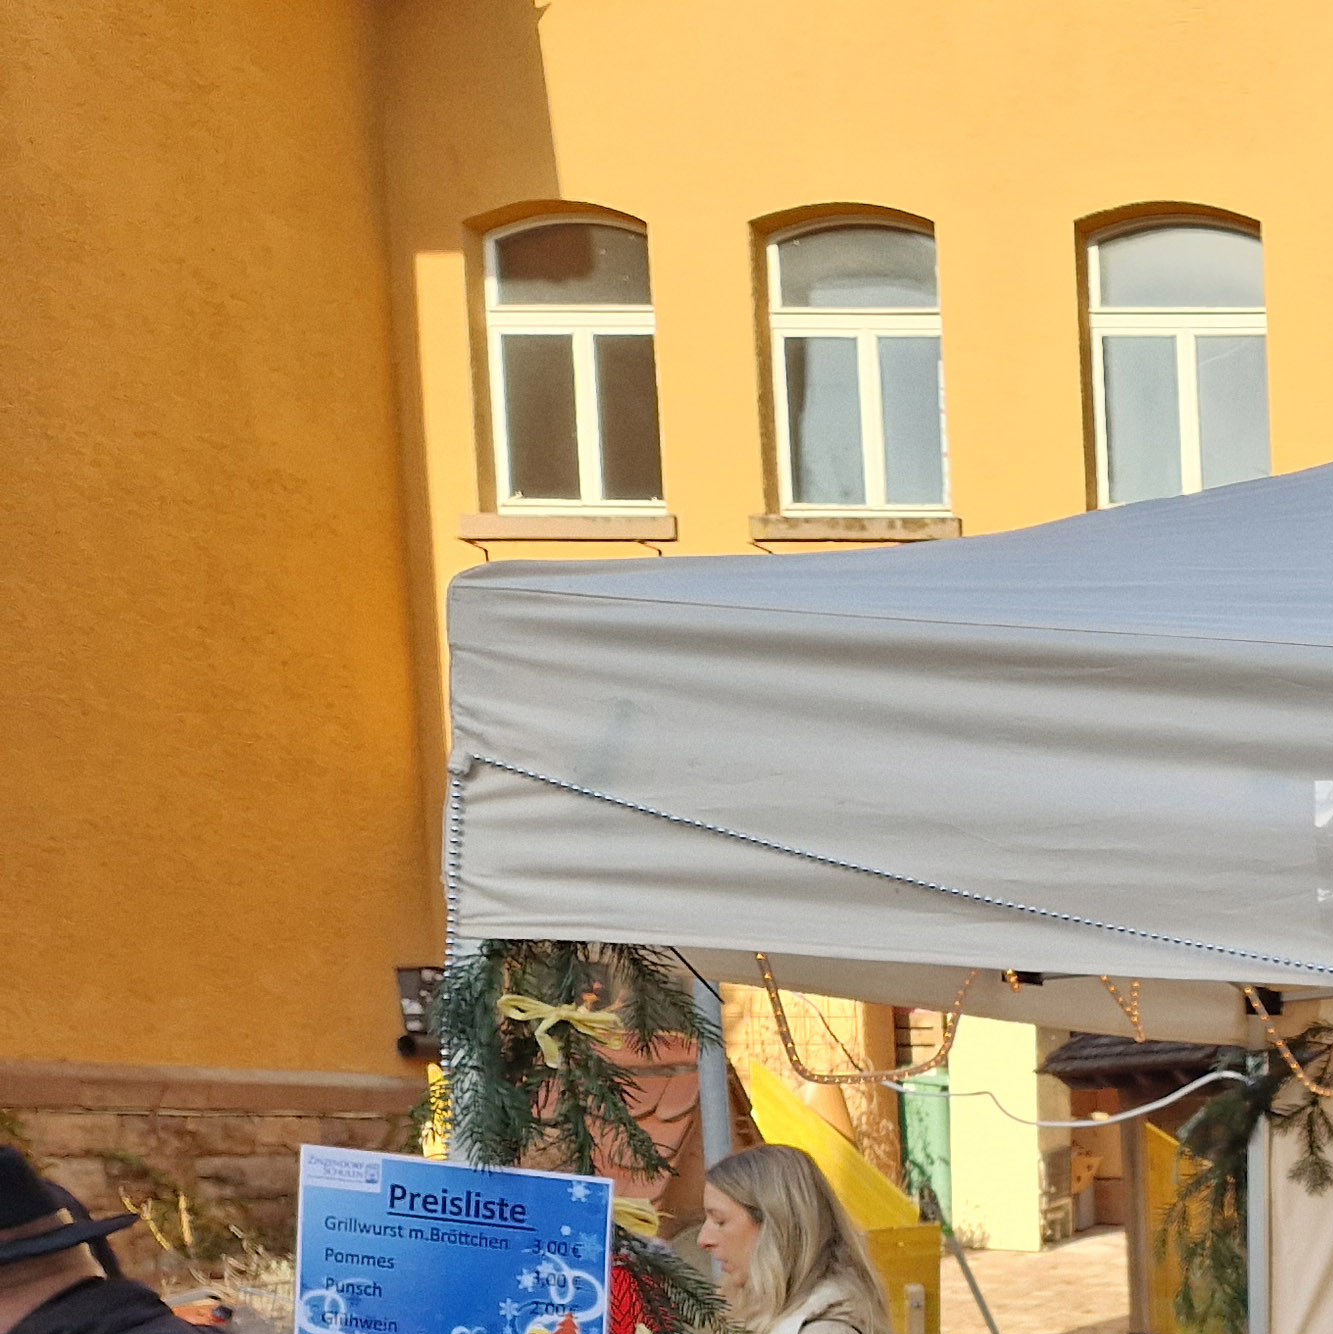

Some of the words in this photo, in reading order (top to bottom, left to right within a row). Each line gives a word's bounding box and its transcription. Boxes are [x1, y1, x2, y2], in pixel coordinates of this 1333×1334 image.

[389, 1184, 529, 1223] Preisliste
[324, 1215, 403, 1239] Grillwurst
[325, 1247, 395, 1269] Pommes
[325, 1277, 382, 1297] Punsch
[322, 1311, 398, 1332] Glühwein
